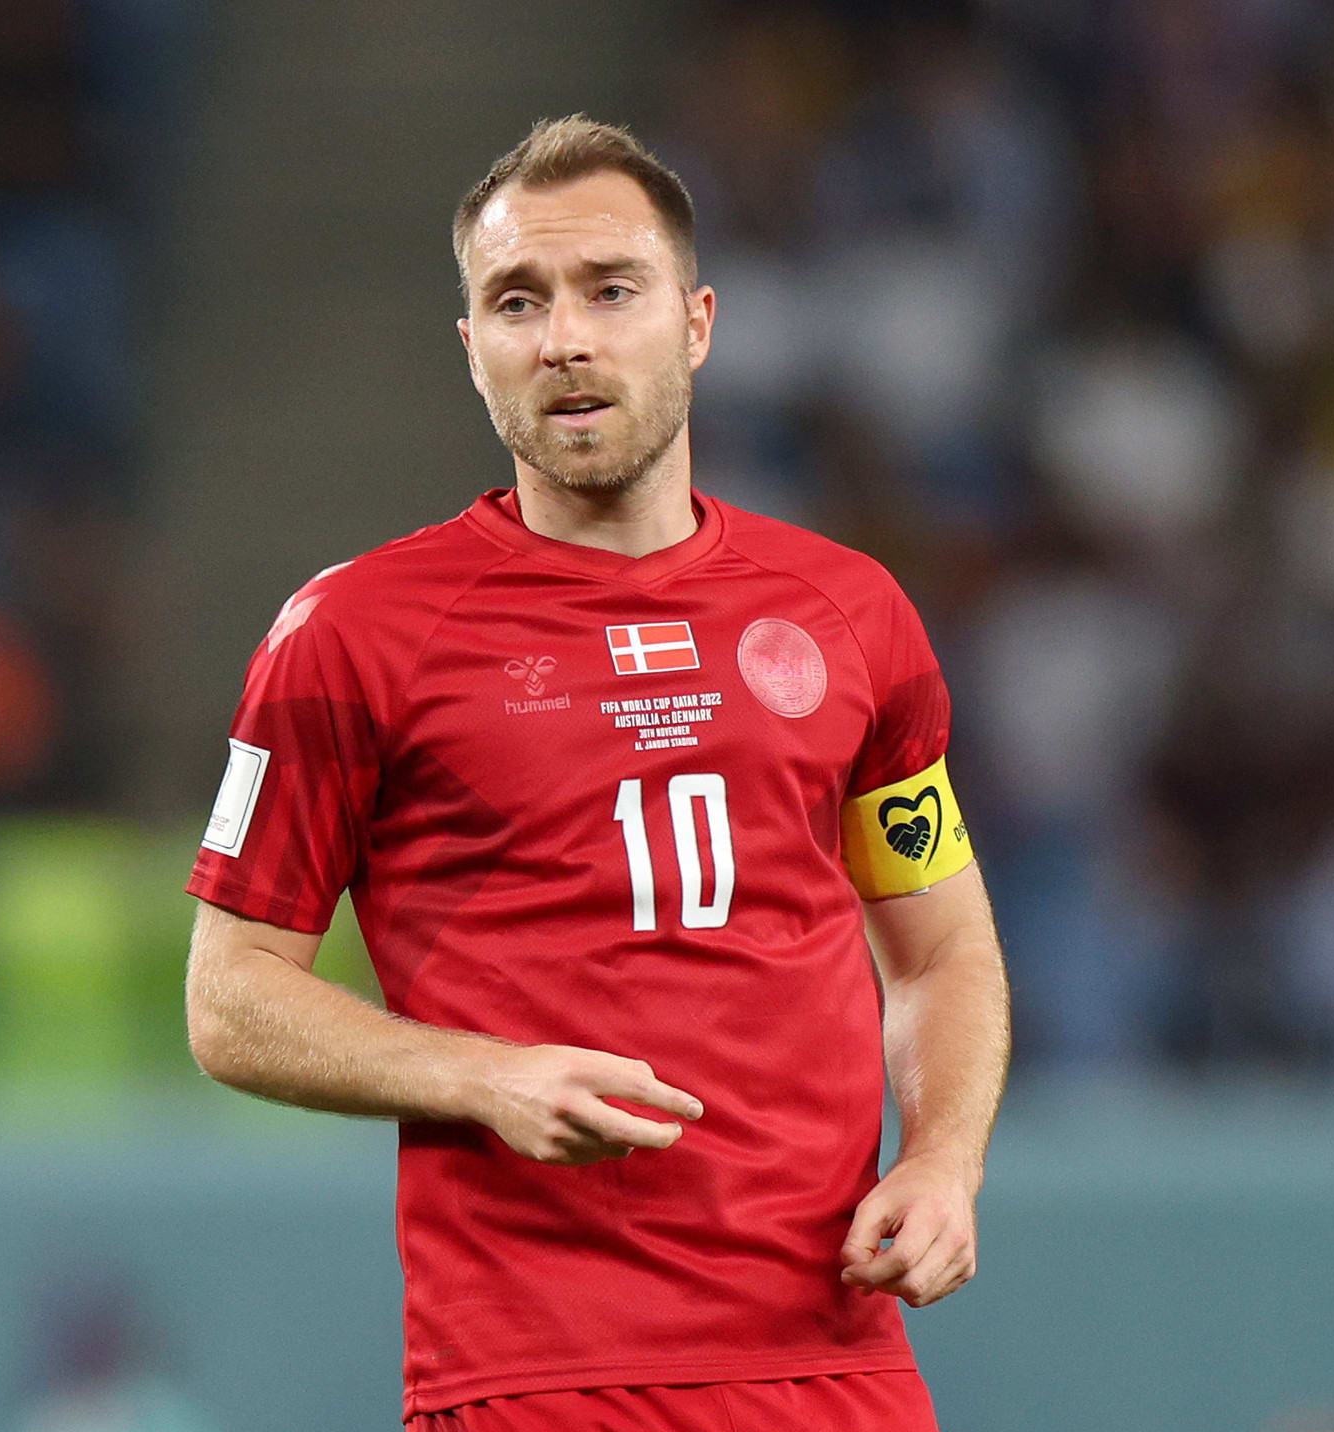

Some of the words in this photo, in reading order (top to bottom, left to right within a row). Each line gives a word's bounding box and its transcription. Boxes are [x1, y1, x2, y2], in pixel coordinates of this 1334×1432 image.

[504, 693, 571, 715] hummel
[600, 701, 620, 714] FIFA
[621, 699, 652, 713] WORLD
[653, 697, 670, 711] CUP
[672, 695, 698, 709] QATAR
[699, 692, 722, 706] 2022
[615, 713, 660, 728] AUSTRALIA
[671, 708, 713, 723] DENMARK
[612, 772, 736, 932] 10
